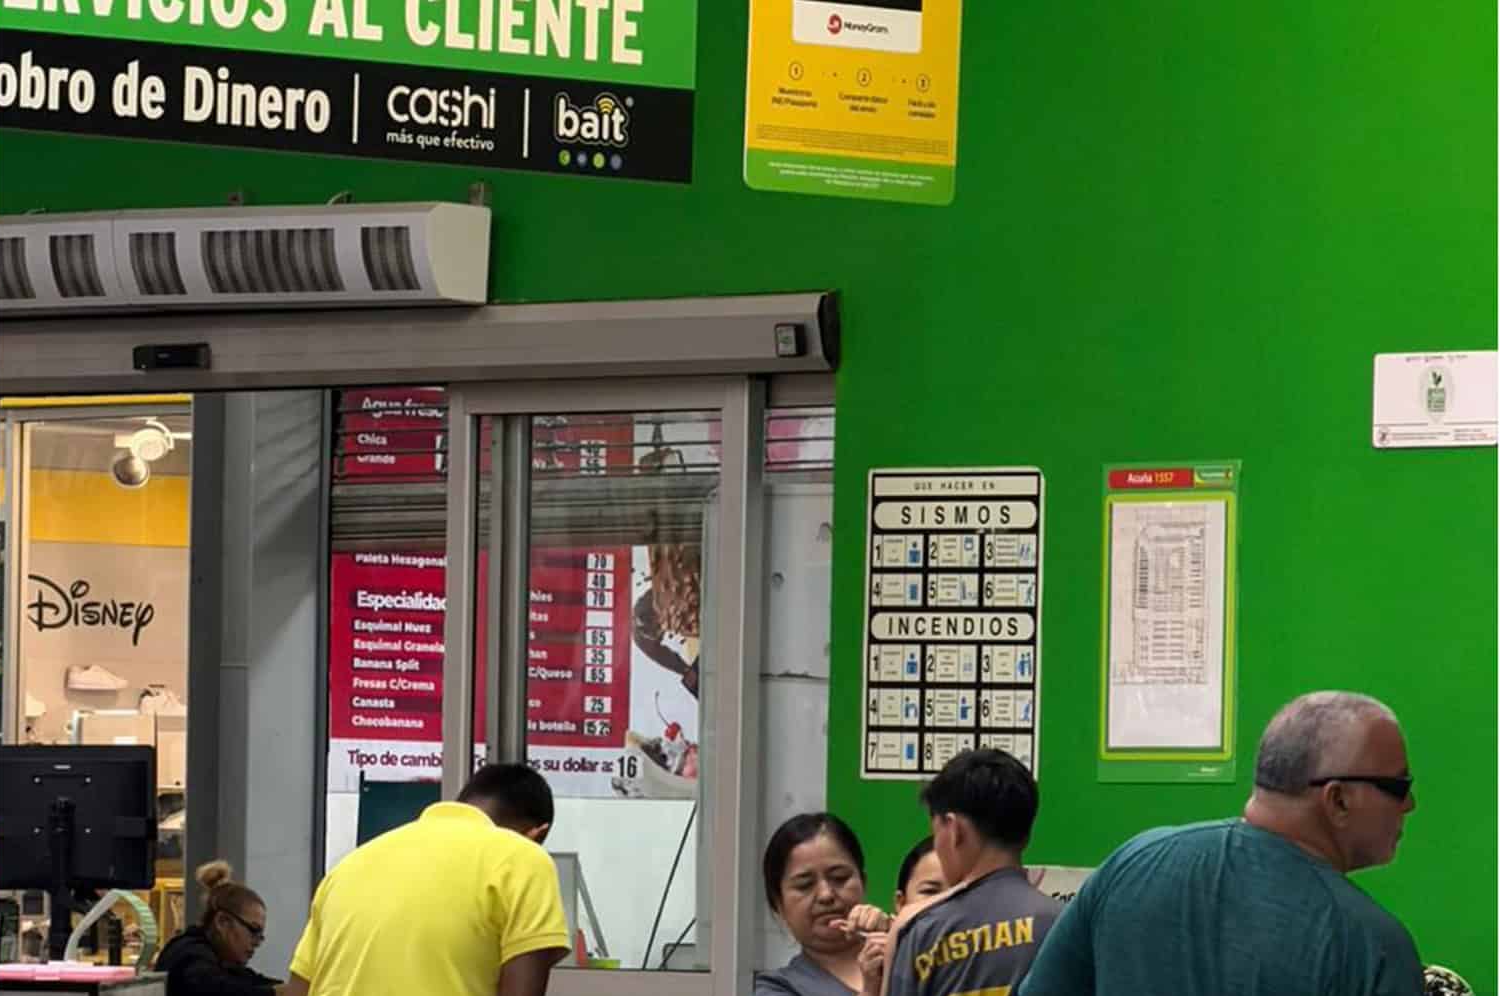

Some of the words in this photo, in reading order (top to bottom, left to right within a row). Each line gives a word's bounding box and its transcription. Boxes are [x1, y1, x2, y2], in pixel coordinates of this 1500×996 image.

[405, 0, 643, 65] CLIENTE
[112, 59, 166, 119] de
[183, 66, 331, 133] Dinero
[387, 85, 496, 129] cashi
[556, 96, 626, 143] bait
[386, 128, 412, 145] más
[416, 133, 441, 149] que
[443, 130, 495, 151] efectivo
[900, 505, 1011, 525] SISMOS
[929, 542, 938, 560] 2
[985, 541, 994, 560] 3
[985, 581, 993, 599] 6
[354, 619, 401, 634] Esquimal
[887, 616, 1019, 637] INCENDIOS
[353, 638, 401, 652] Esquimal
[353, 657, 393, 670] Banana
[926, 654, 934, 673] 2
[983, 654, 990, 673] 3
[352, 677, 387, 690] Fresas
[352, 696, 395, 709] Canasta
[982, 699, 990, 717] 6
[351, 715, 425, 729] Chocobanana
[347, 750, 379, 768] Tipo
[380, 751, 398, 767] de
[617, 755, 638, 779] 16
